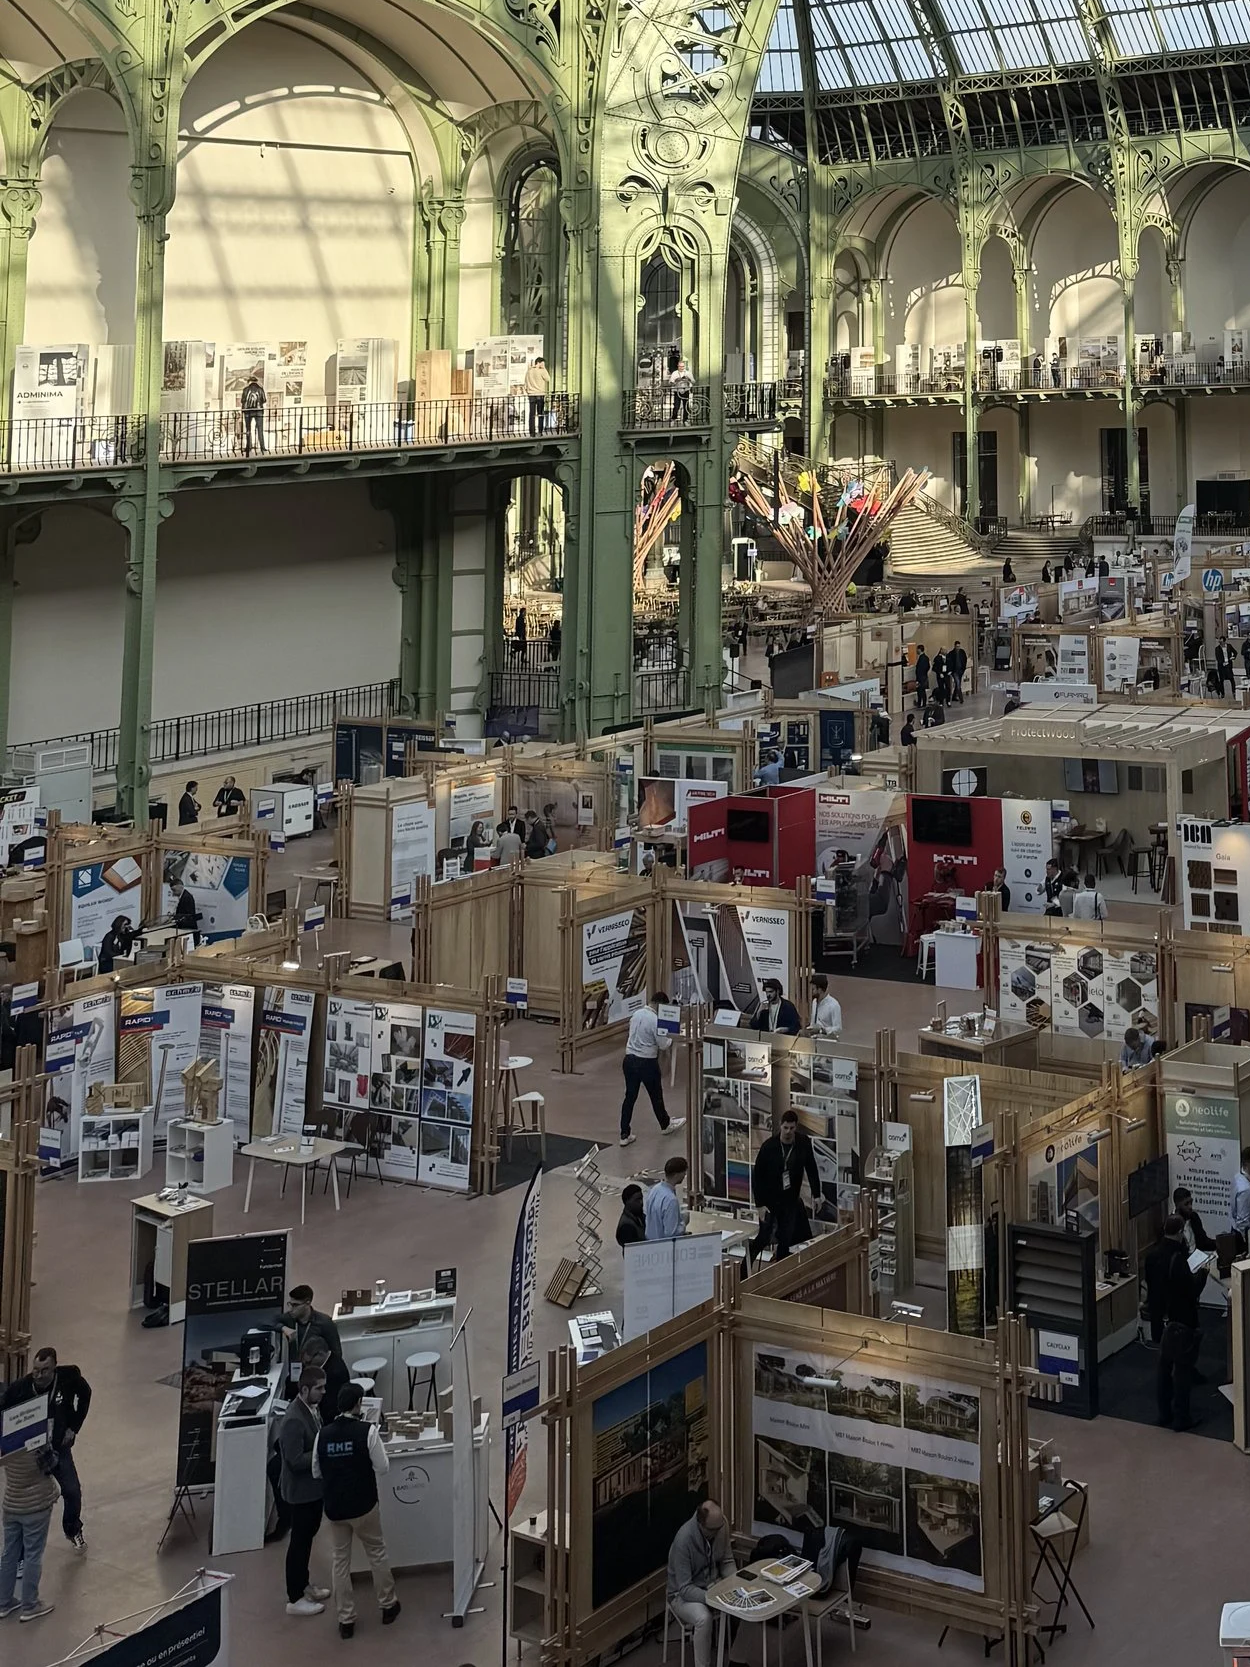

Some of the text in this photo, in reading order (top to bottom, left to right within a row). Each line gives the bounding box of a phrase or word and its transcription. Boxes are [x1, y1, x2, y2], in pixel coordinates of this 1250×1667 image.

[17, 391, 64, 399] ADMINIMA
[693, 827, 725, 843] HILTI
[752, 915, 786, 926] VERNISSEO
[1192, 1105, 1229, 1119] neolife
[188, 1275, 283, 1301] STELLAR
[147, 1626, 206, 1666] ou en présentiel
